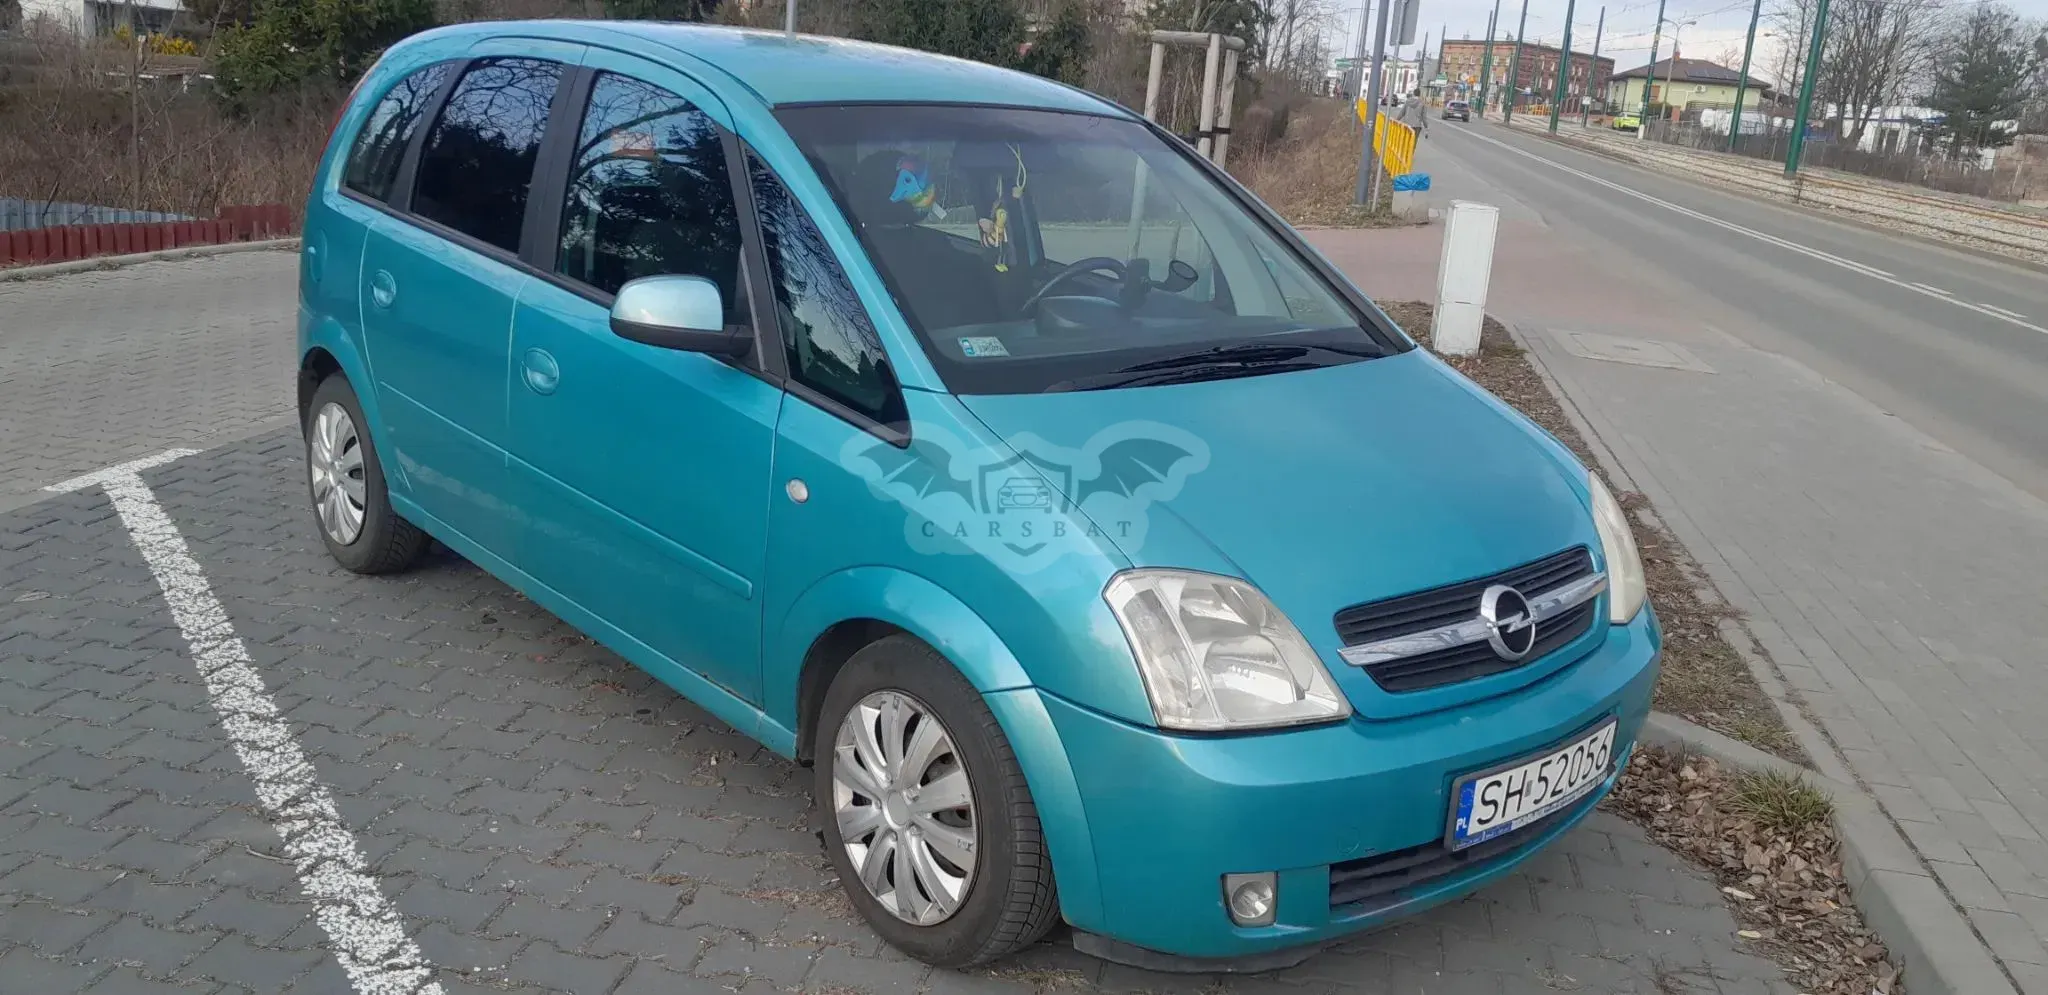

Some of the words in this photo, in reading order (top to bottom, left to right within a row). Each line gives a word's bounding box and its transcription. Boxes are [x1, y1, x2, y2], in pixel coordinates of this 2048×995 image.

[1476, 769, 1528, 826] SH
[1533, 727, 1612, 805] 52056
[1455, 816, 1468, 832] PL
